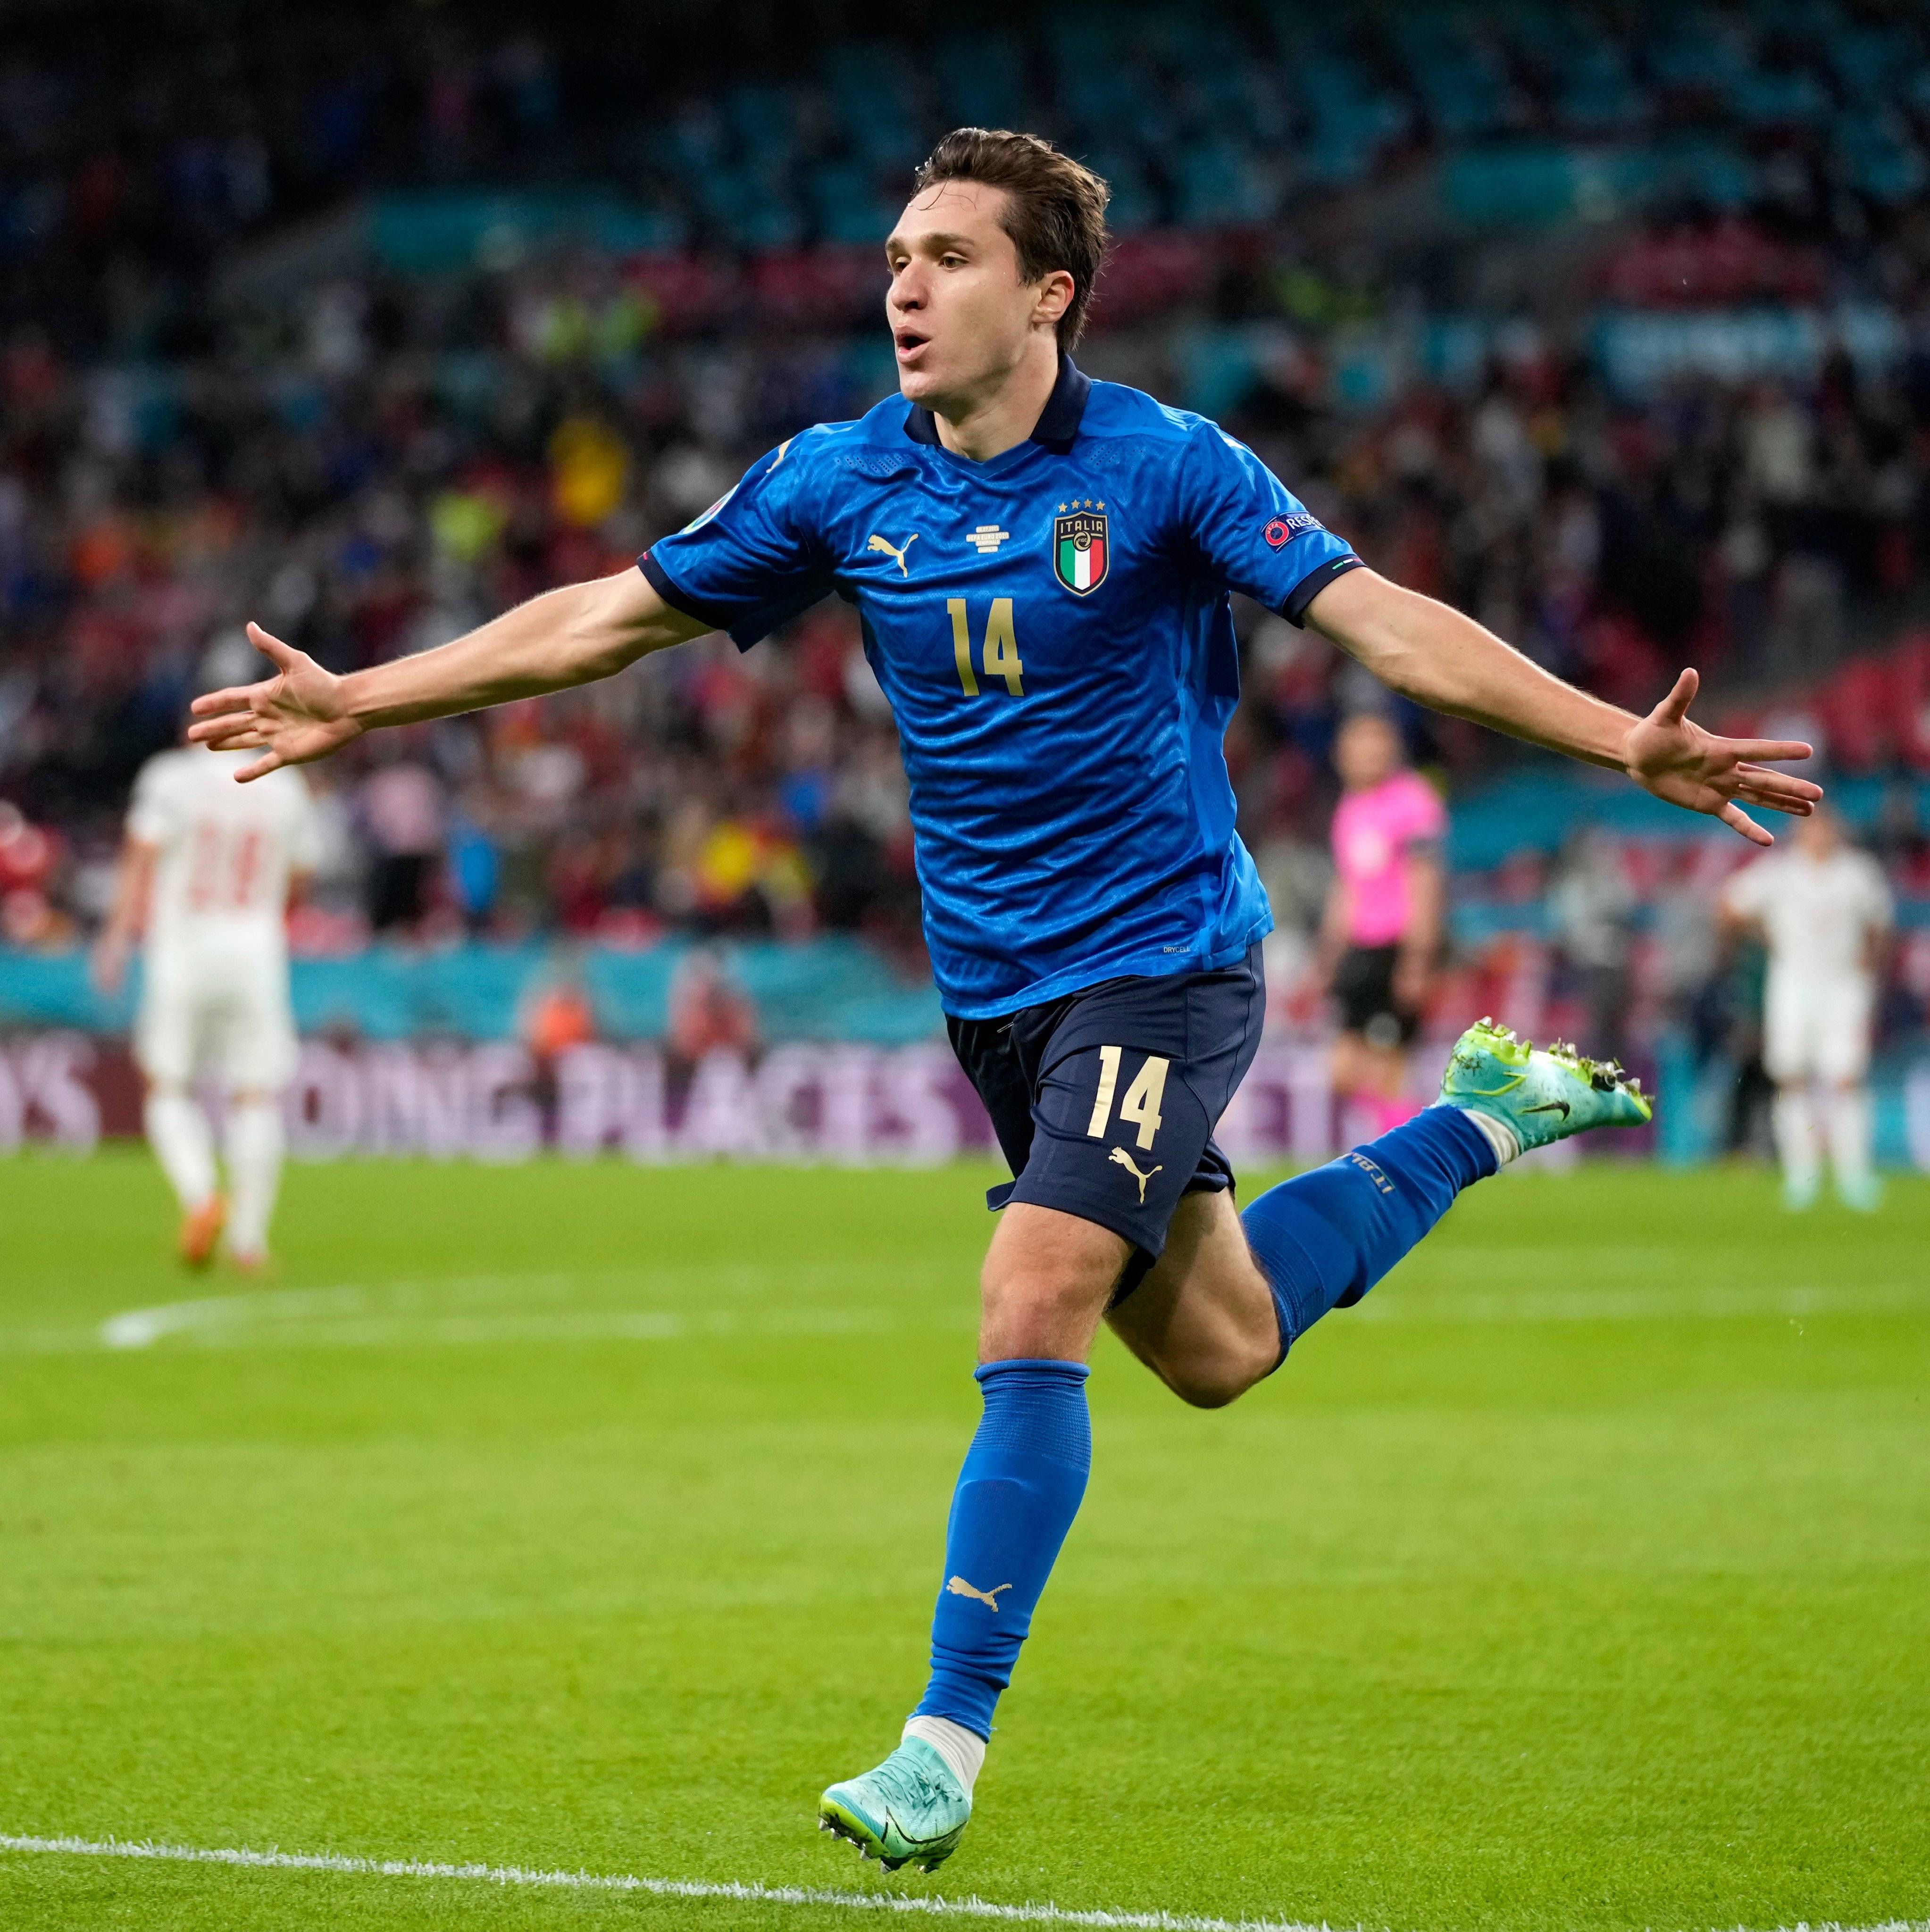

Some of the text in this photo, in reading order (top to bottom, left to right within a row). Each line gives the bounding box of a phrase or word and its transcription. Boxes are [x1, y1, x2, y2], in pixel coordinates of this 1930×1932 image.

[1061, 520, 1103, 533] ITALIA
[1267, 523, 1278, 534] UEFA
[947, 598, 1024, 697] 14
[1087, 1045, 1170, 1150] 14
